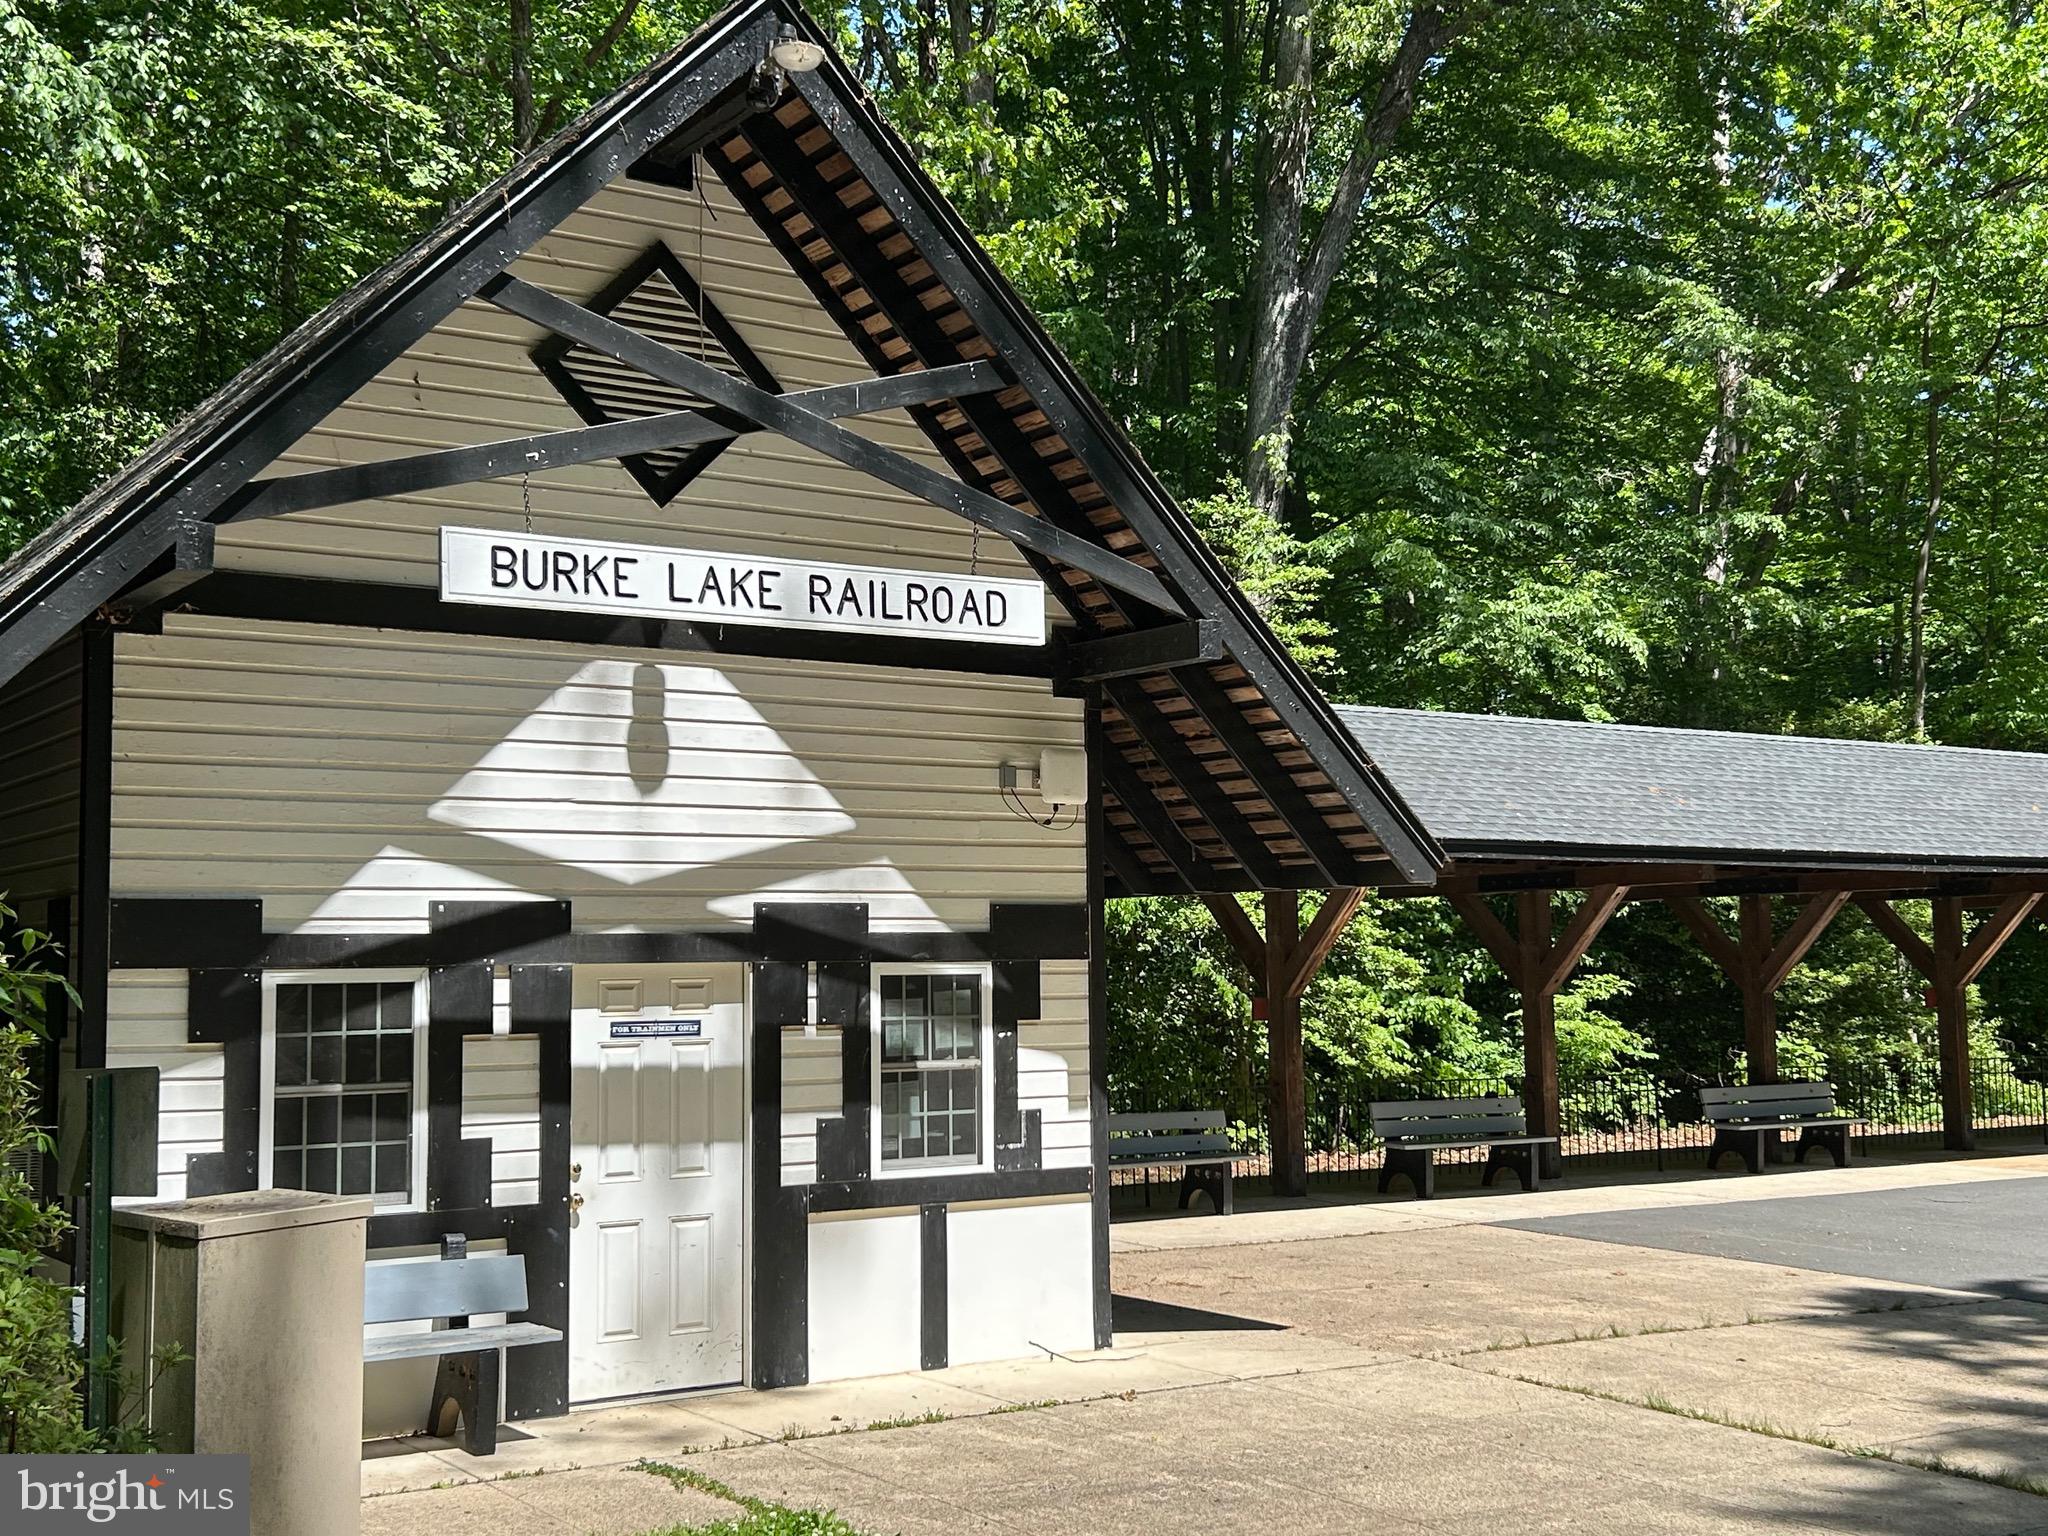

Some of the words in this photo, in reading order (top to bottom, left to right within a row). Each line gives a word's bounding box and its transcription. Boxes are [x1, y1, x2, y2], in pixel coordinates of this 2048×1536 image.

[490, 545, 639, 599] BURKE
[668, 561, 782, 611] LAKE
[808, 574, 1008, 628] RAILROAD
[631, 1025, 676, 1033] TRAINMEN
